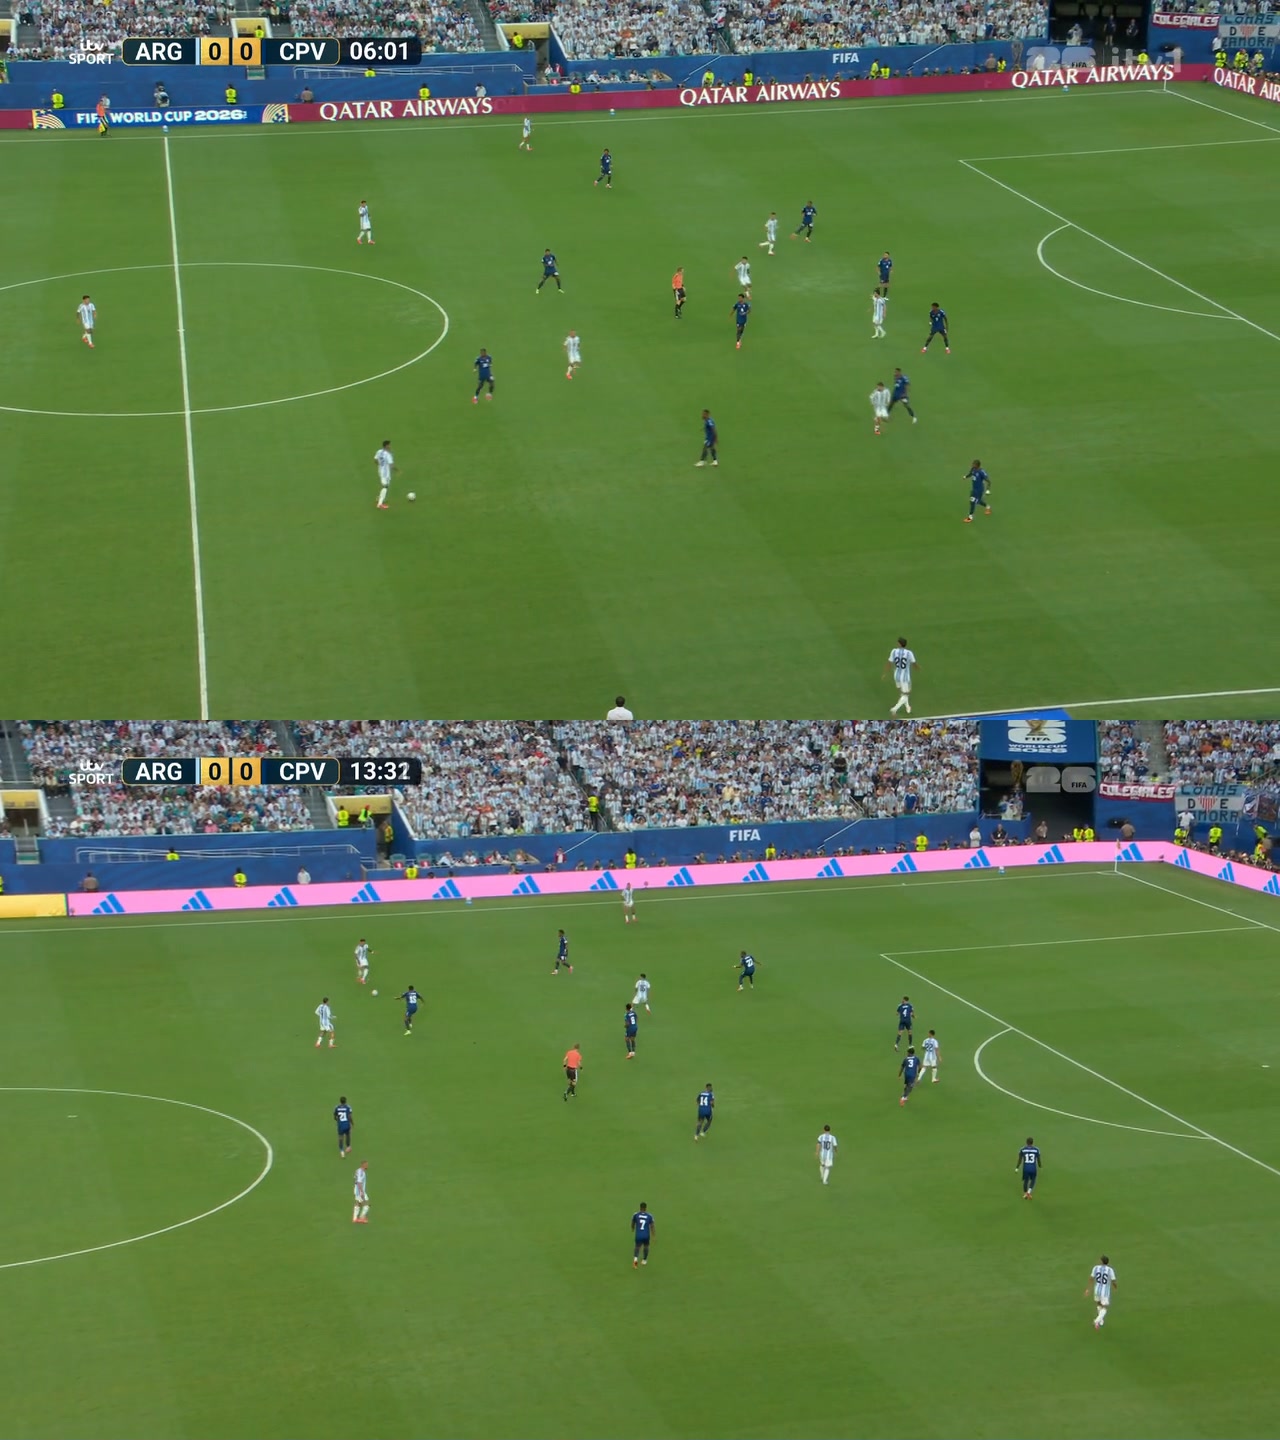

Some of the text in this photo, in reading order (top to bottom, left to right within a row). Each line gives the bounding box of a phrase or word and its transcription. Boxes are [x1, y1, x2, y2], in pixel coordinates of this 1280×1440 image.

[832, 52, 859, 64] FIFA
[1011, 64, 1174, 88] QATAR AIRWAYS
[1214, 67, 1256, 95] QATAR
[680, 82, 840, 106] QATAR AIRWAYS
[319, 97, 493, 121] QATAR AIRWAYS
[76, 110, 242, 124] FIF WORLD CUP 2026
[1187, 798, 1229, 809] D E
[730, 829, 761, 842] FIFA
[907, 1059, 914, 1068] 3
[700, 1097, 708, 1106] 14
[1024, 1153, 1035, 1164] 13
[639, 1219, 646, 1230] 7
[1095, 1272, 1108, 1284] 26
